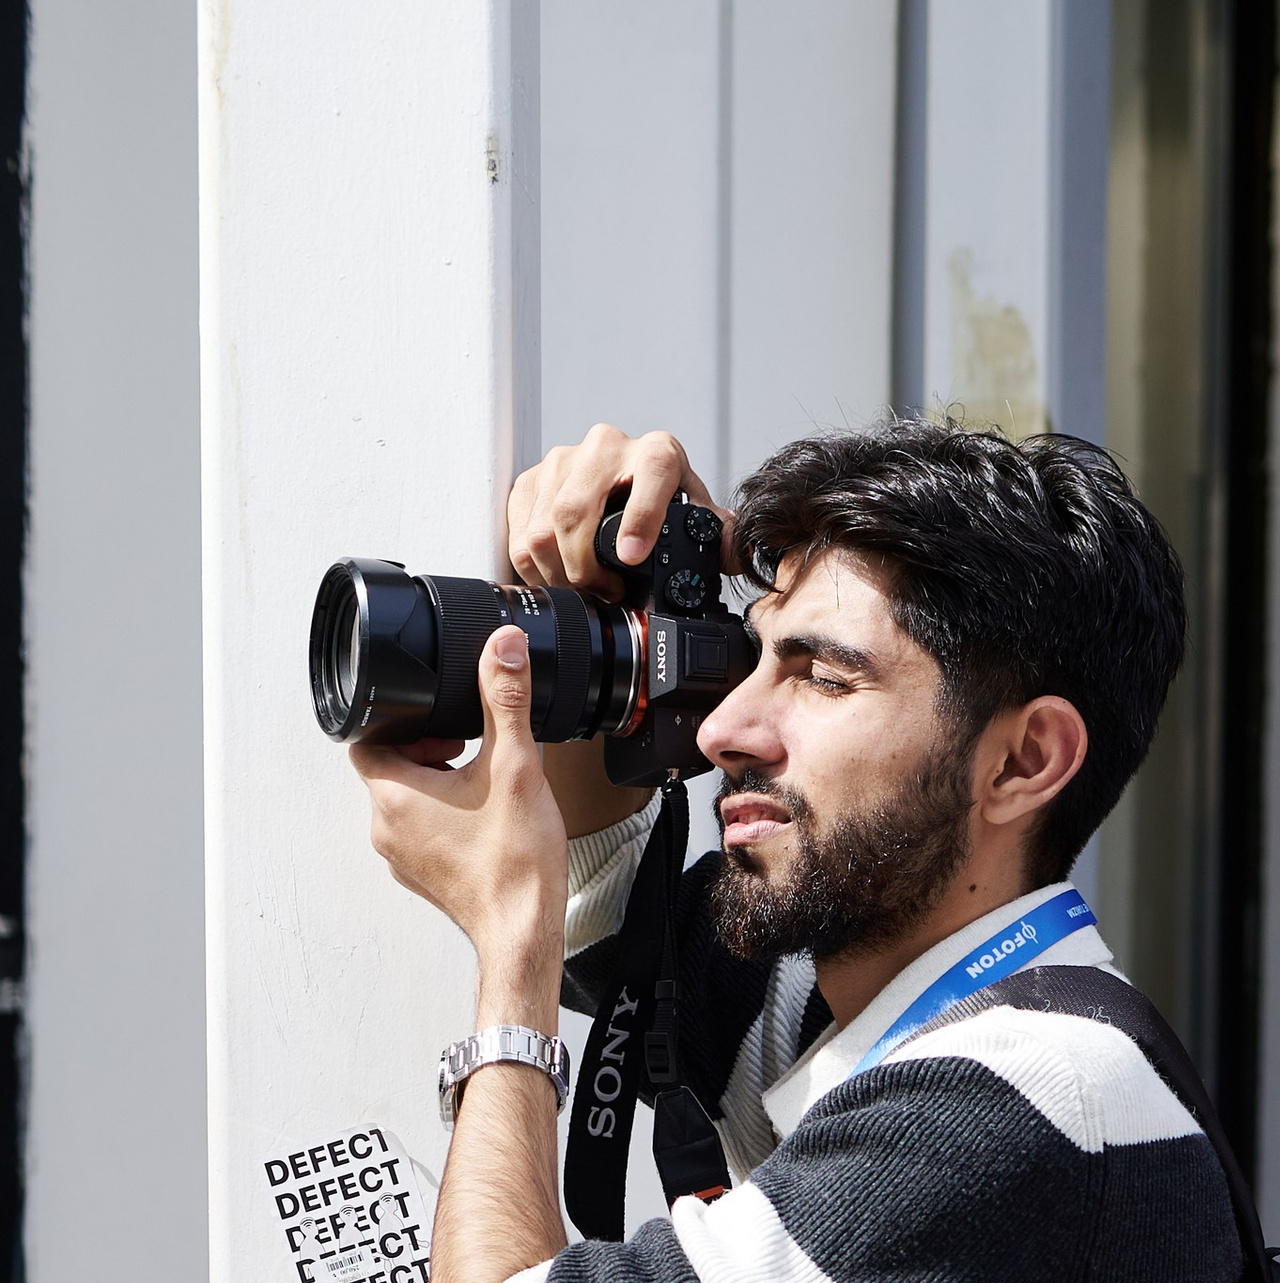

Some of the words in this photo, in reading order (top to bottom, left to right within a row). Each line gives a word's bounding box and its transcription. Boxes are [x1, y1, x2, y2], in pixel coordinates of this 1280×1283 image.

[656, 630, 667, 683] SONY
[965, 930, 1027, 979] FOTON
[587, 985, 640, 1138] SONY
[264, 1128, 389, 1187] DEFECT
[274, 1159, 400, 1220] DEFECT
